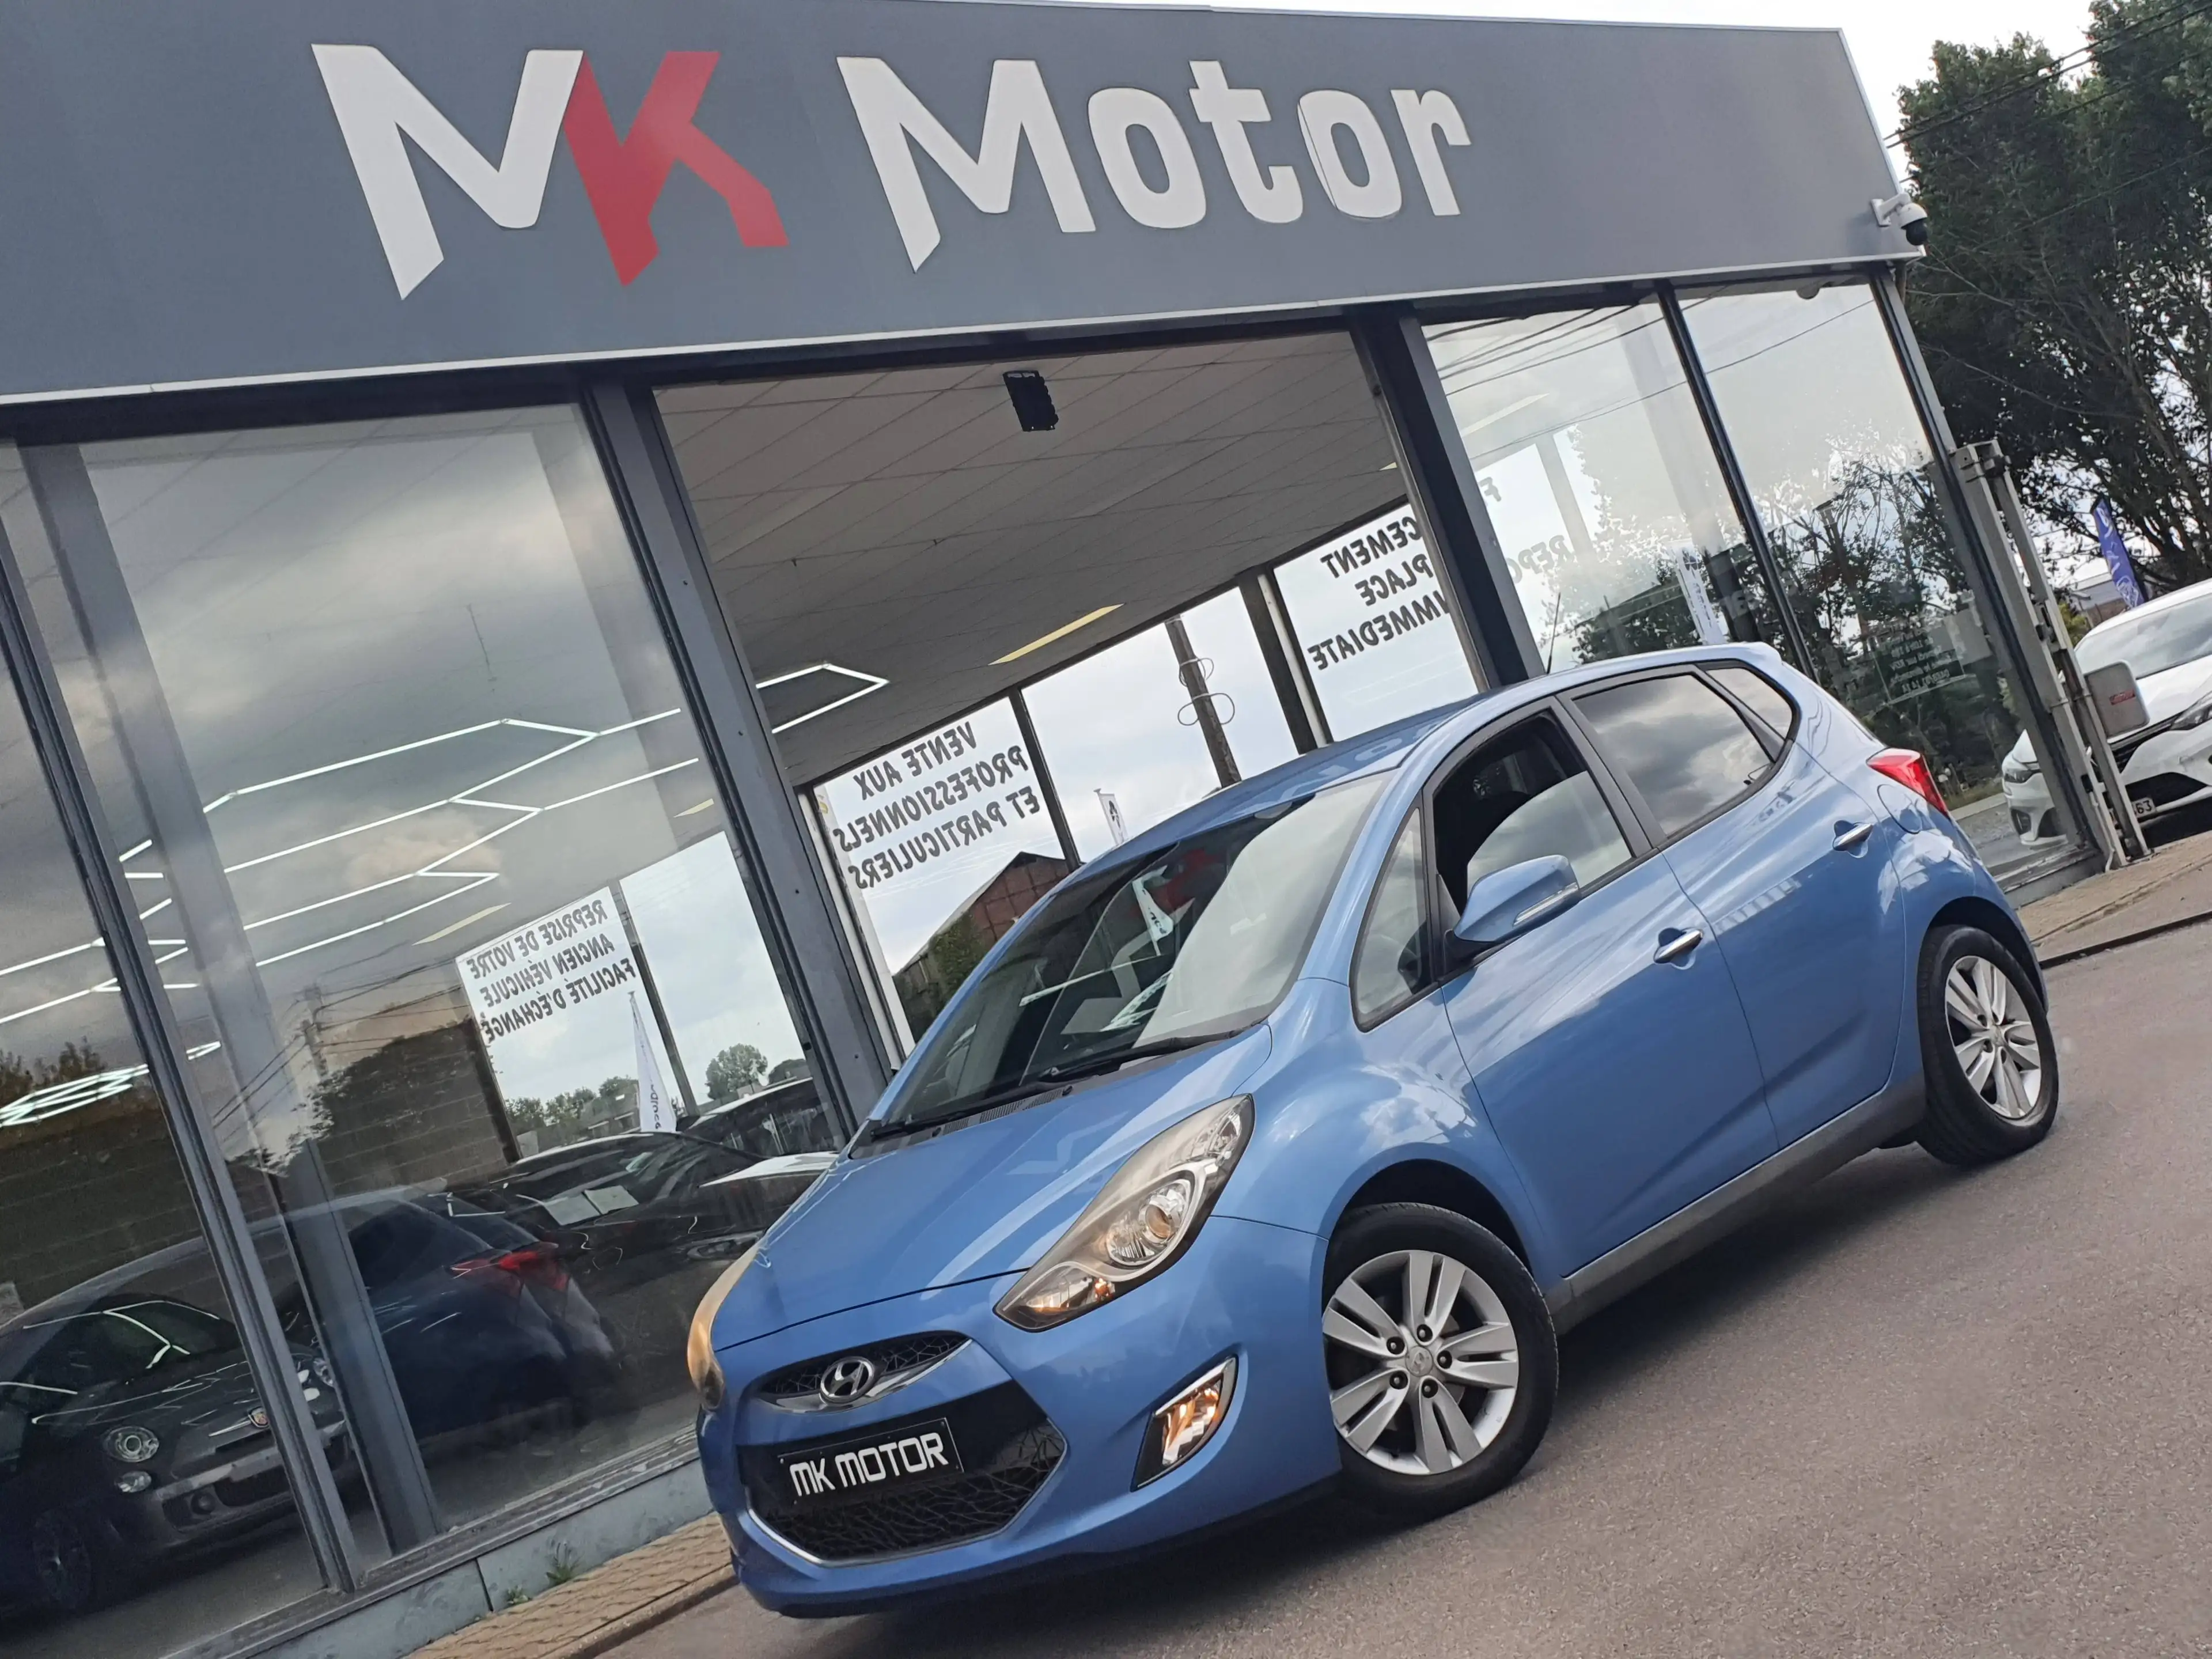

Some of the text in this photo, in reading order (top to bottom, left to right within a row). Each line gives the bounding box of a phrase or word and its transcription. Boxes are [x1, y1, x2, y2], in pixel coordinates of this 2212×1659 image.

[311, 43, 1472, 300] MK Motor
[789, 1431, 949, 1497] MK MOTOR
